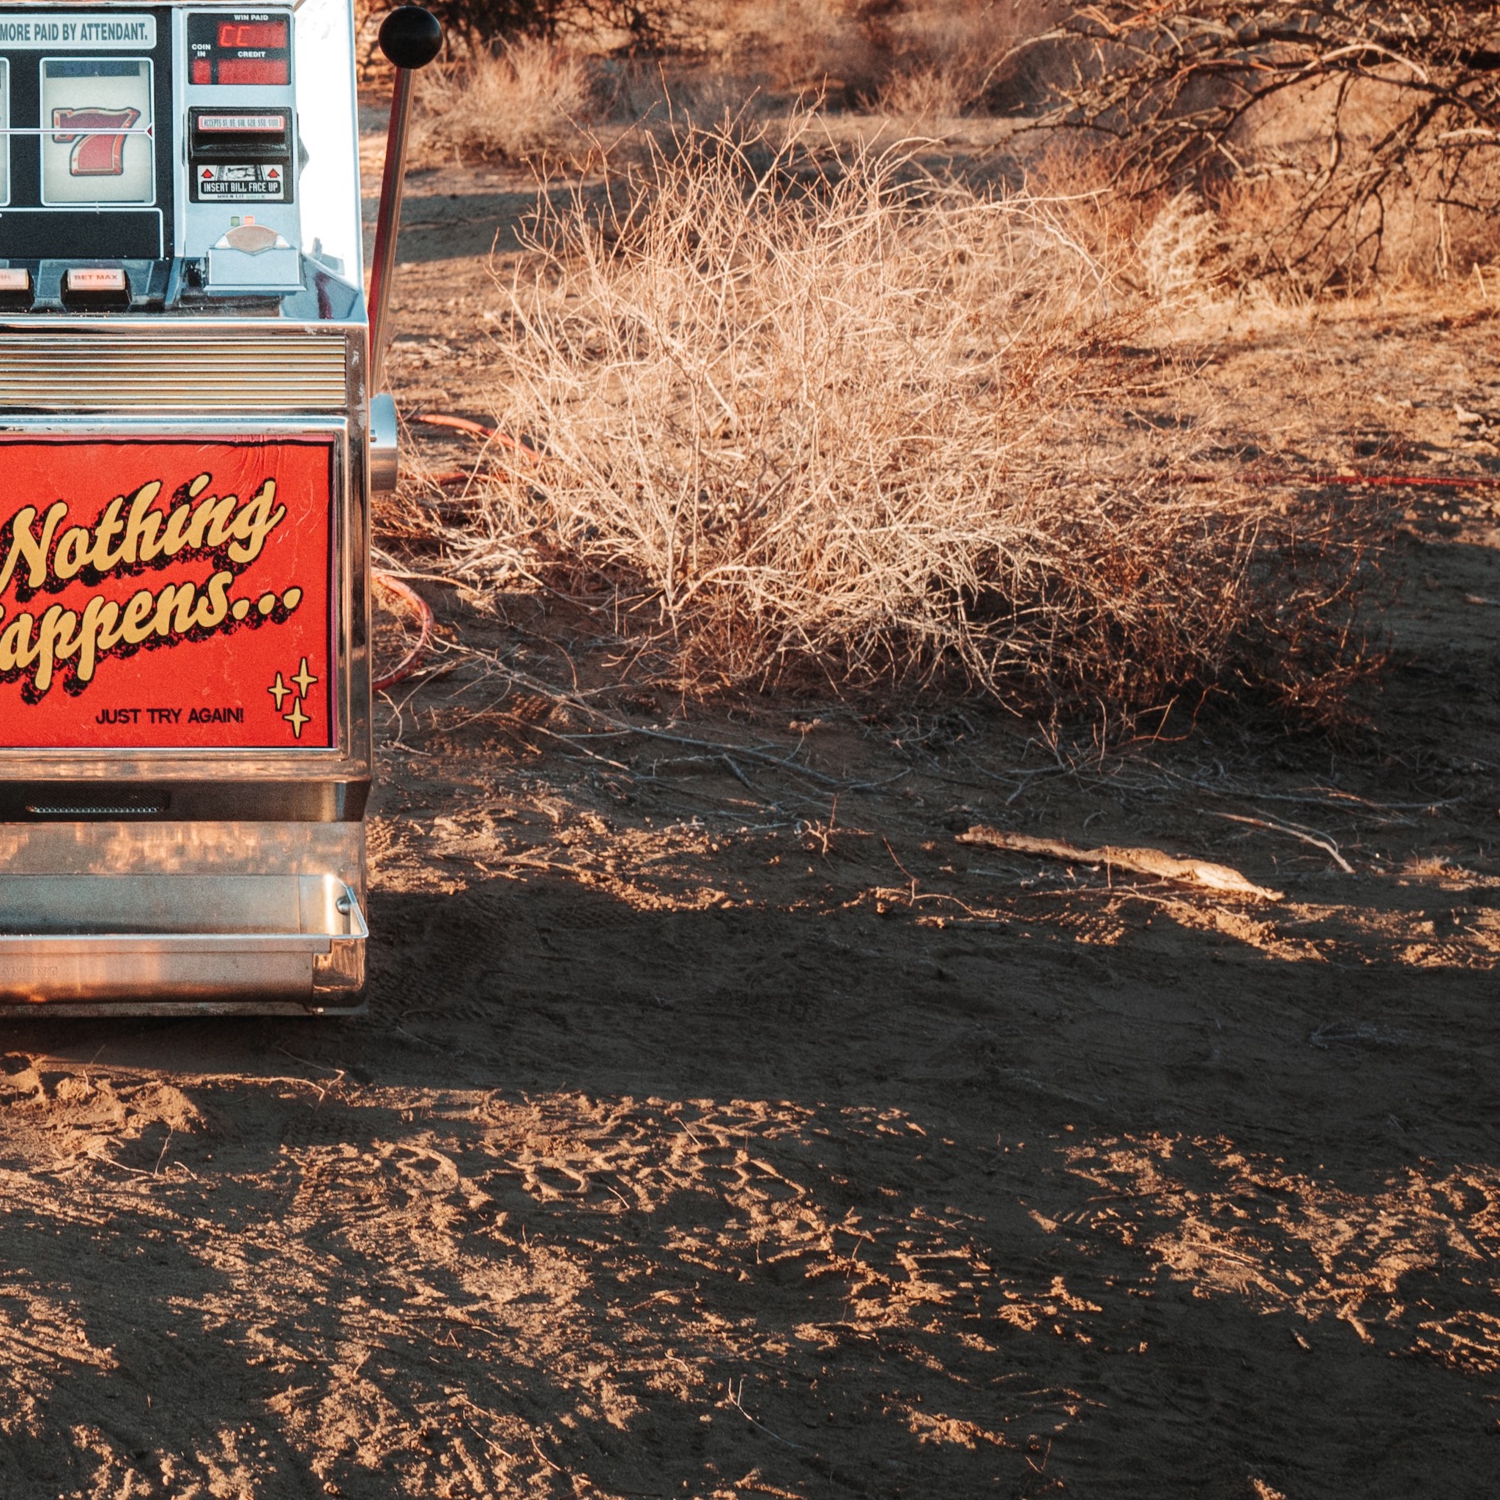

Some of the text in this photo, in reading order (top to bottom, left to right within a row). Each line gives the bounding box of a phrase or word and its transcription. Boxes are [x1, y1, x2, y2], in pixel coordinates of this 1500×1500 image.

[0, 22, 31, 42] MORE
[34, 22, 59, 42] PAID
[62, 22, 77, 42] BY
[80, 22, 148, 42] ATTENDANT.
[51, 106, 141, 177] 7
[203, 182, 278, 193] INSERT BILL FACE UP
[95, 707, 245, 724] JUST TRY AGAIN!
